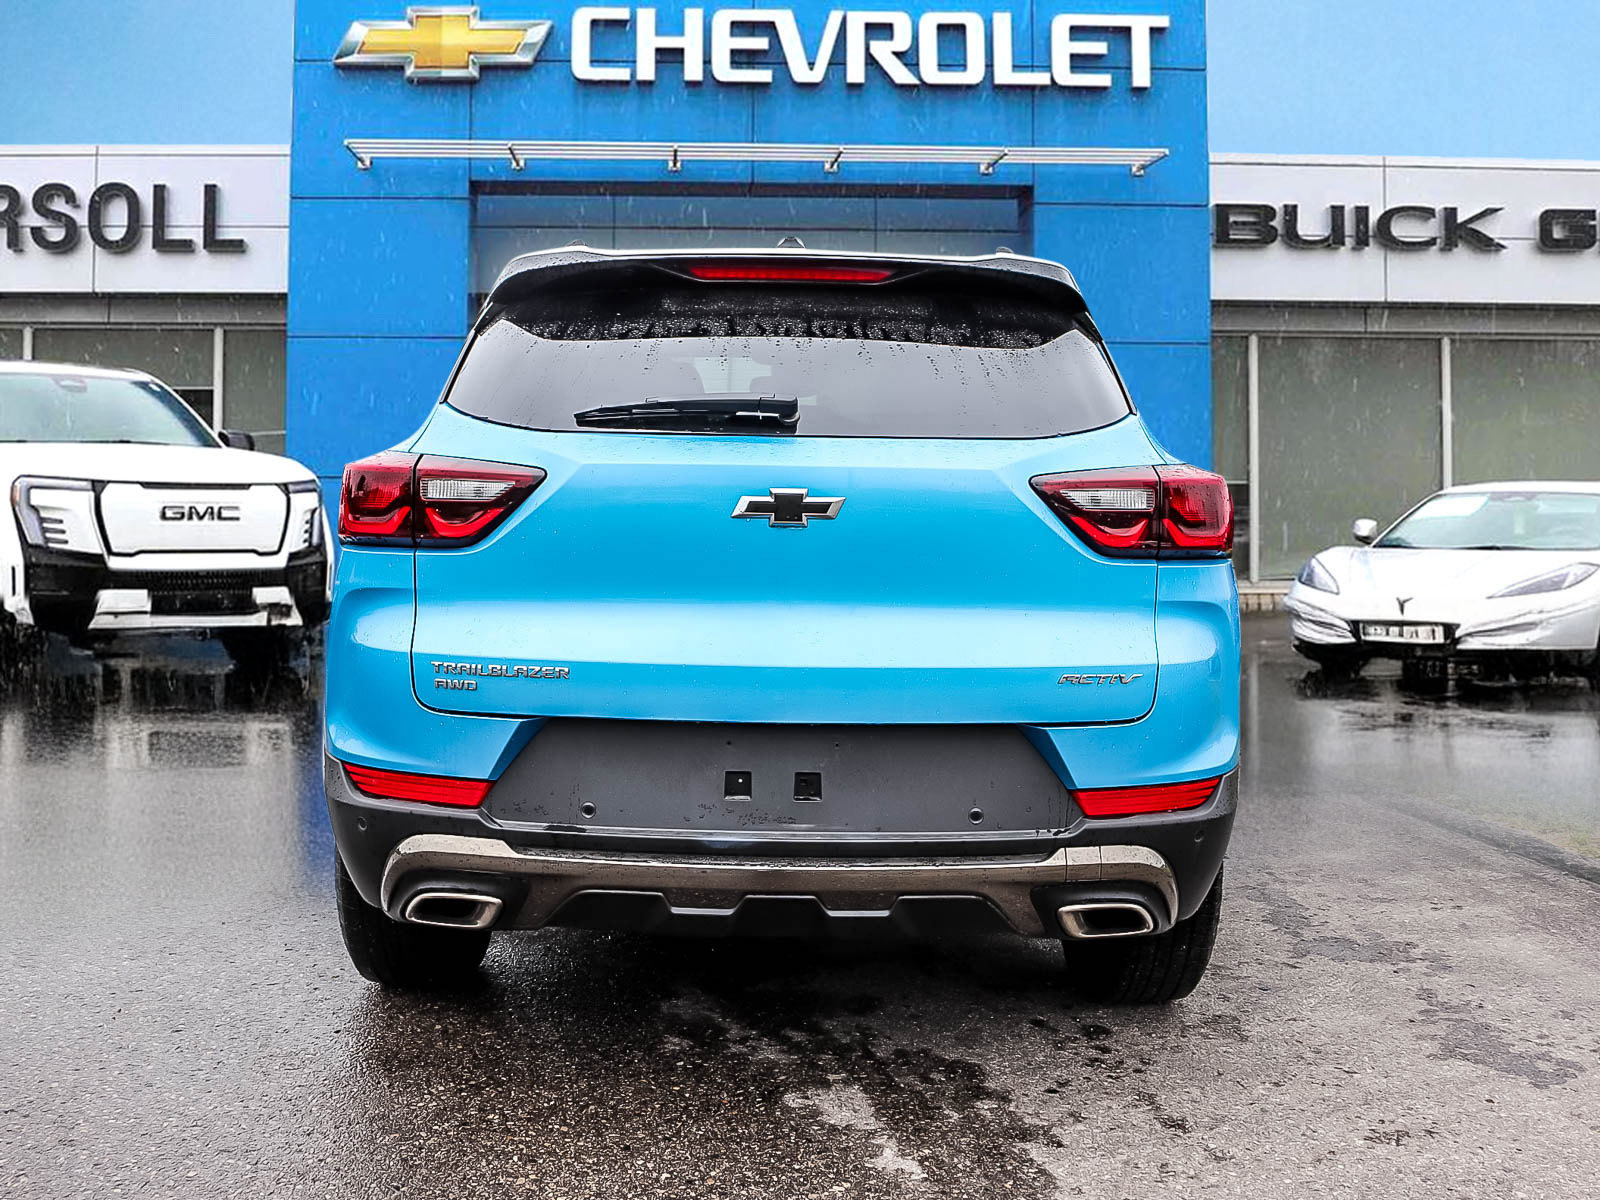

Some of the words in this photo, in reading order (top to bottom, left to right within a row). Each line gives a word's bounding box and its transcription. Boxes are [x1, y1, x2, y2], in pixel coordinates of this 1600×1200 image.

[570, 6, 1170, 89] CHEVROLET
[1214, 203, 1506, 251] BUICK
[159, 505, 241, 521] GMC
[430, 660, 570, 680] TRAILBLAZER
[434, 678, 478, 691] AWD
[1057, 673, 1144, 686] ACTIV
